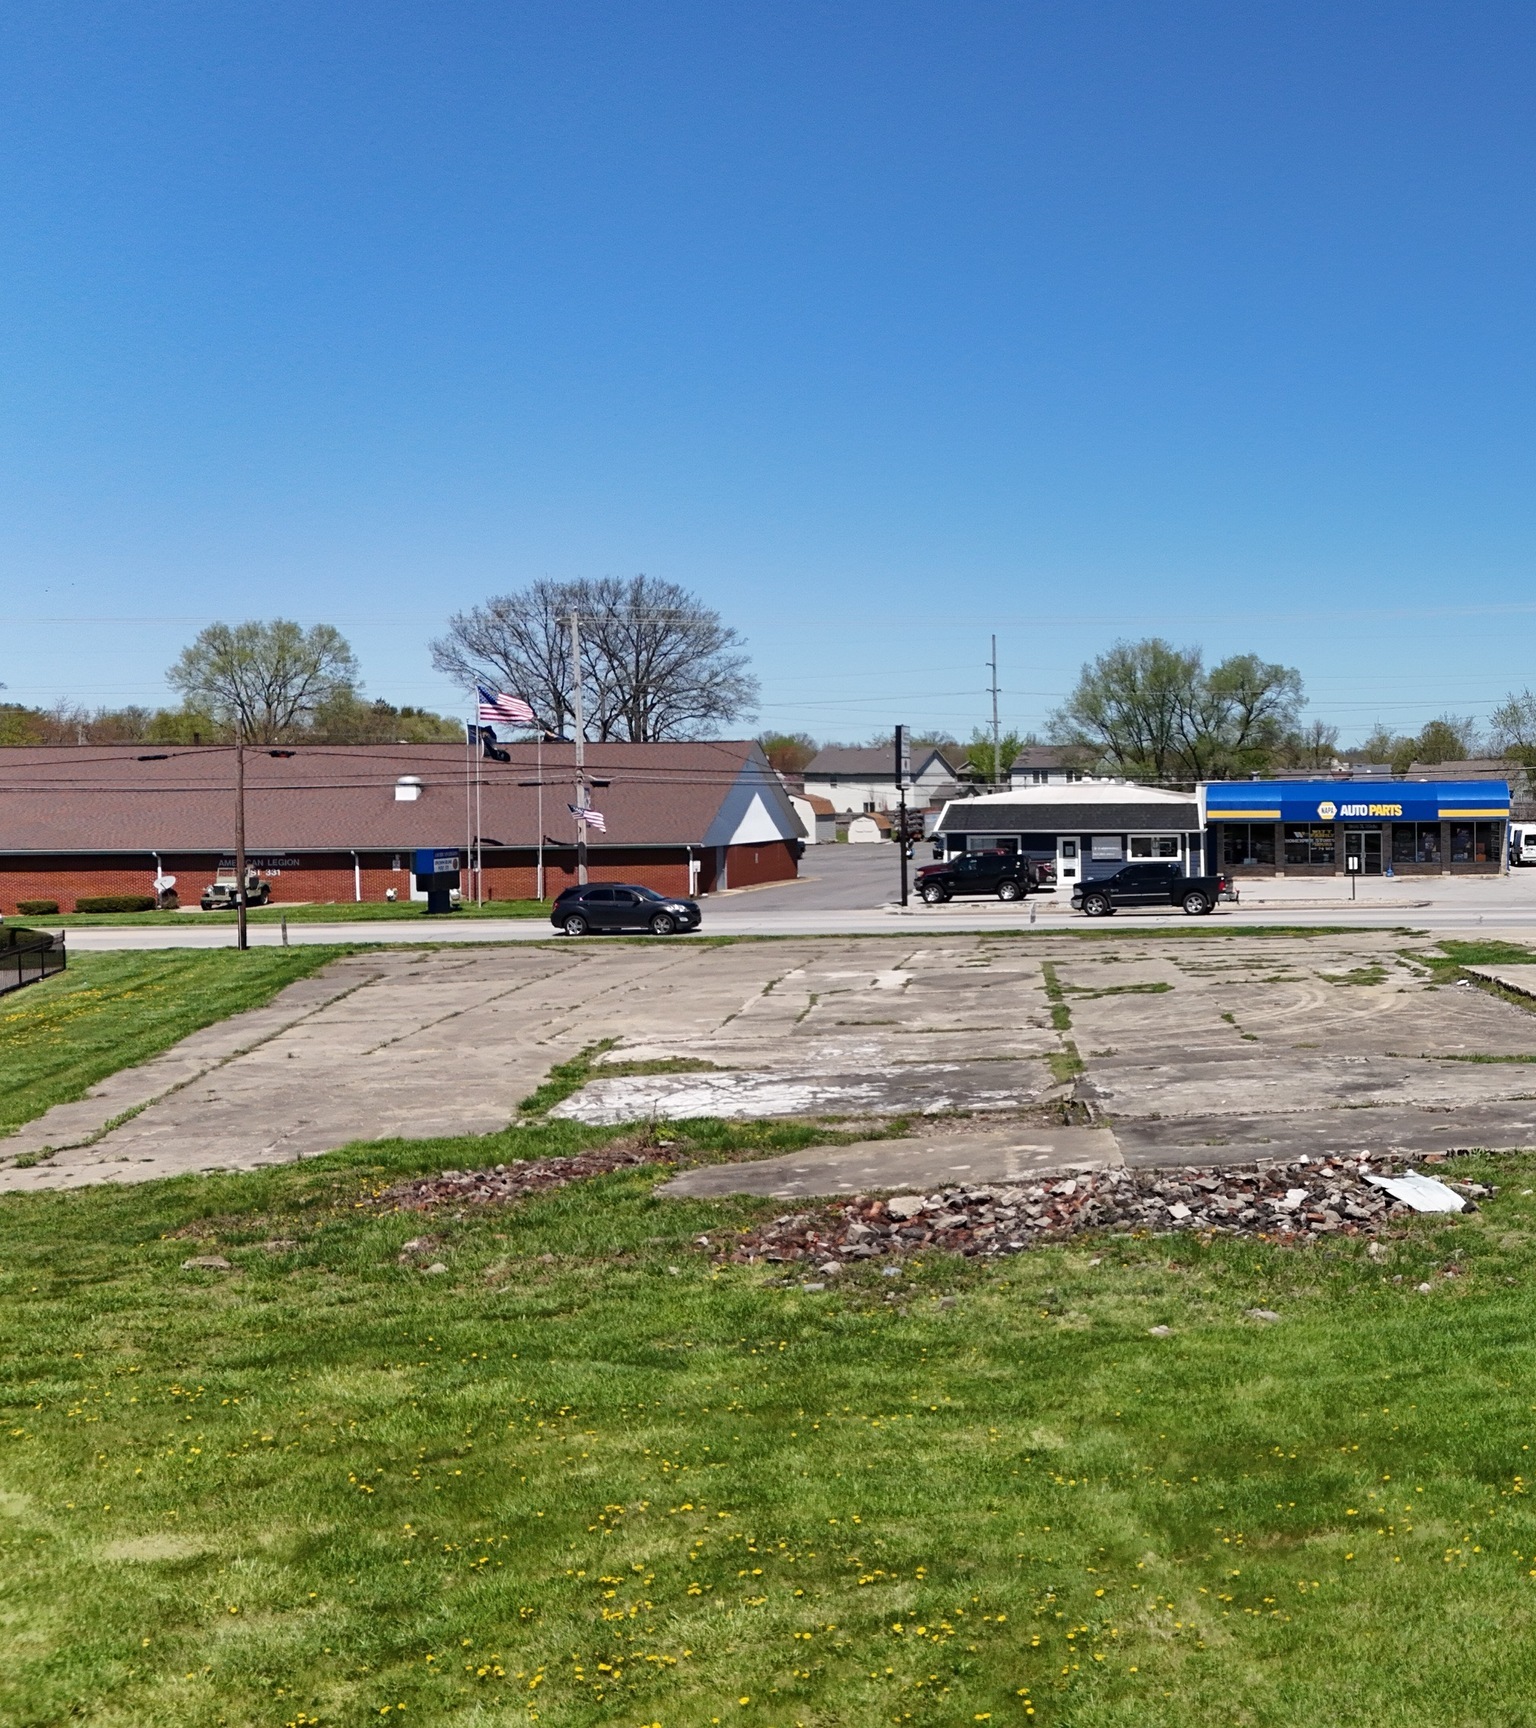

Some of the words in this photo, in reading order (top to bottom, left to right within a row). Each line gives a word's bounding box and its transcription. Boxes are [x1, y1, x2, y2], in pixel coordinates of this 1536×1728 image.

[1321, 806, 1334, 814] NAPA
[1340, 804, 1368, 816] AUTO
[1369, 804, 1402, 816] PARTS
